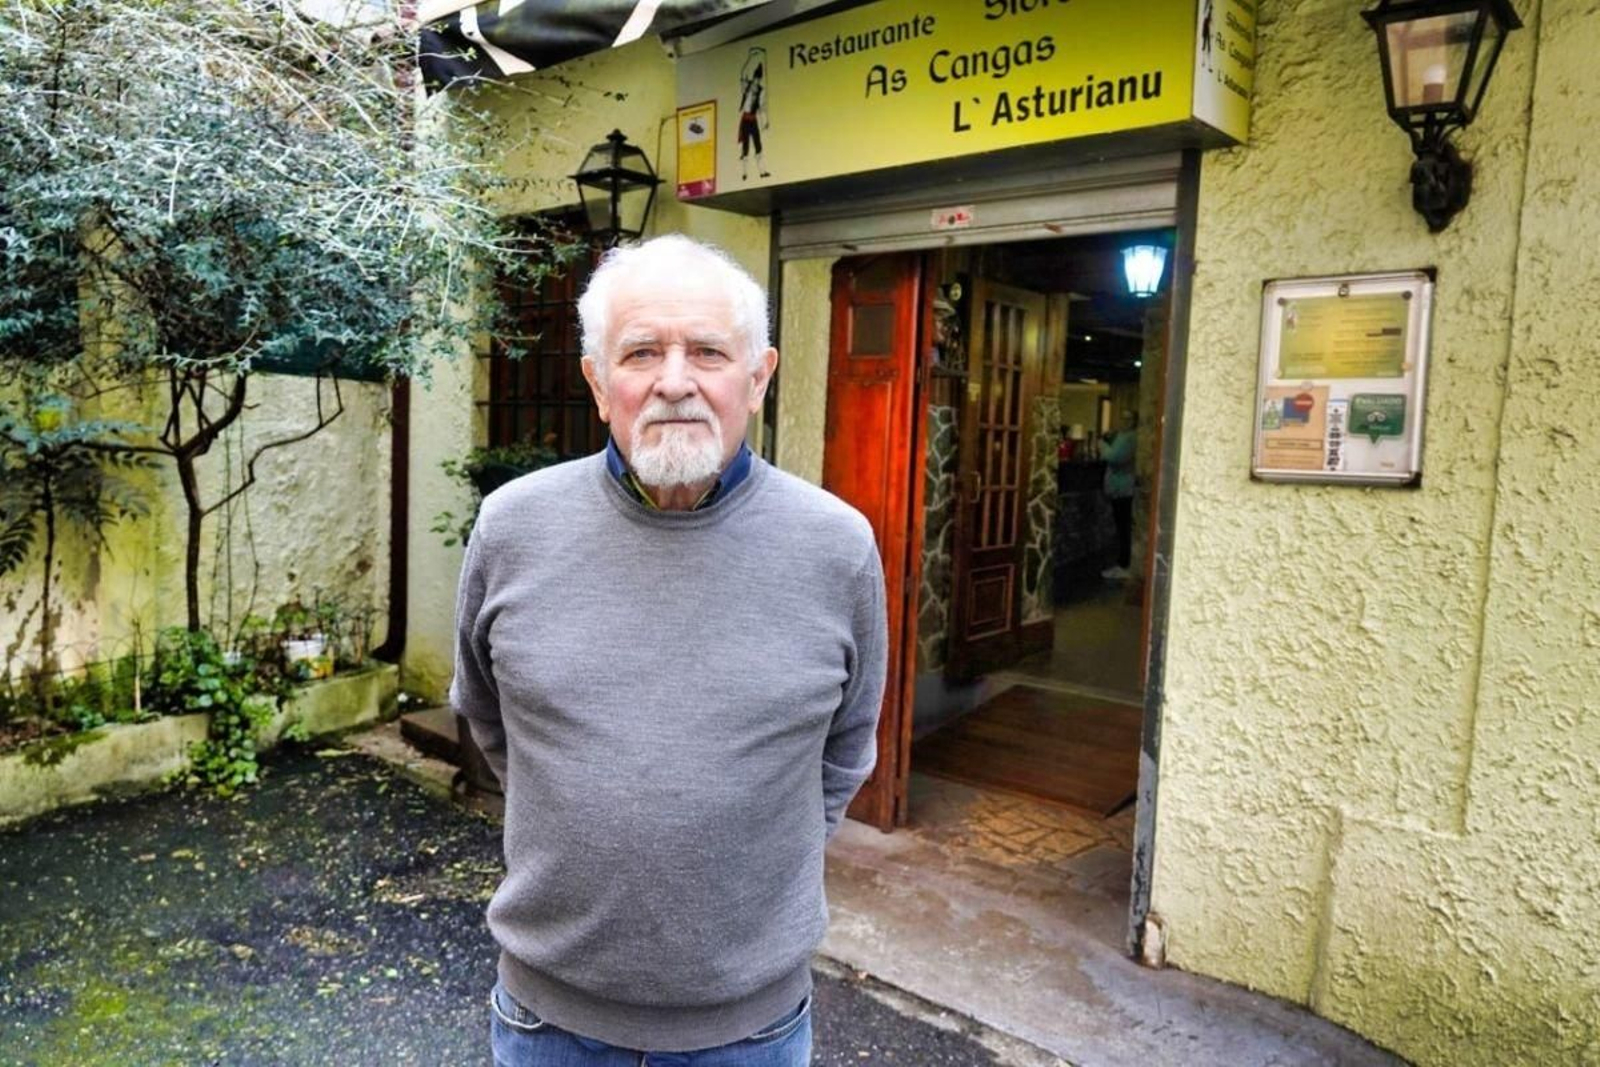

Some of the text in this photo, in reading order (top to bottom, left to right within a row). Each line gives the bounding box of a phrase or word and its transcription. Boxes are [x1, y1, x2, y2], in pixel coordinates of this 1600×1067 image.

[789, 14, 936, 69] Restaurante
[865, 35, 1056, 98] As Cangas
